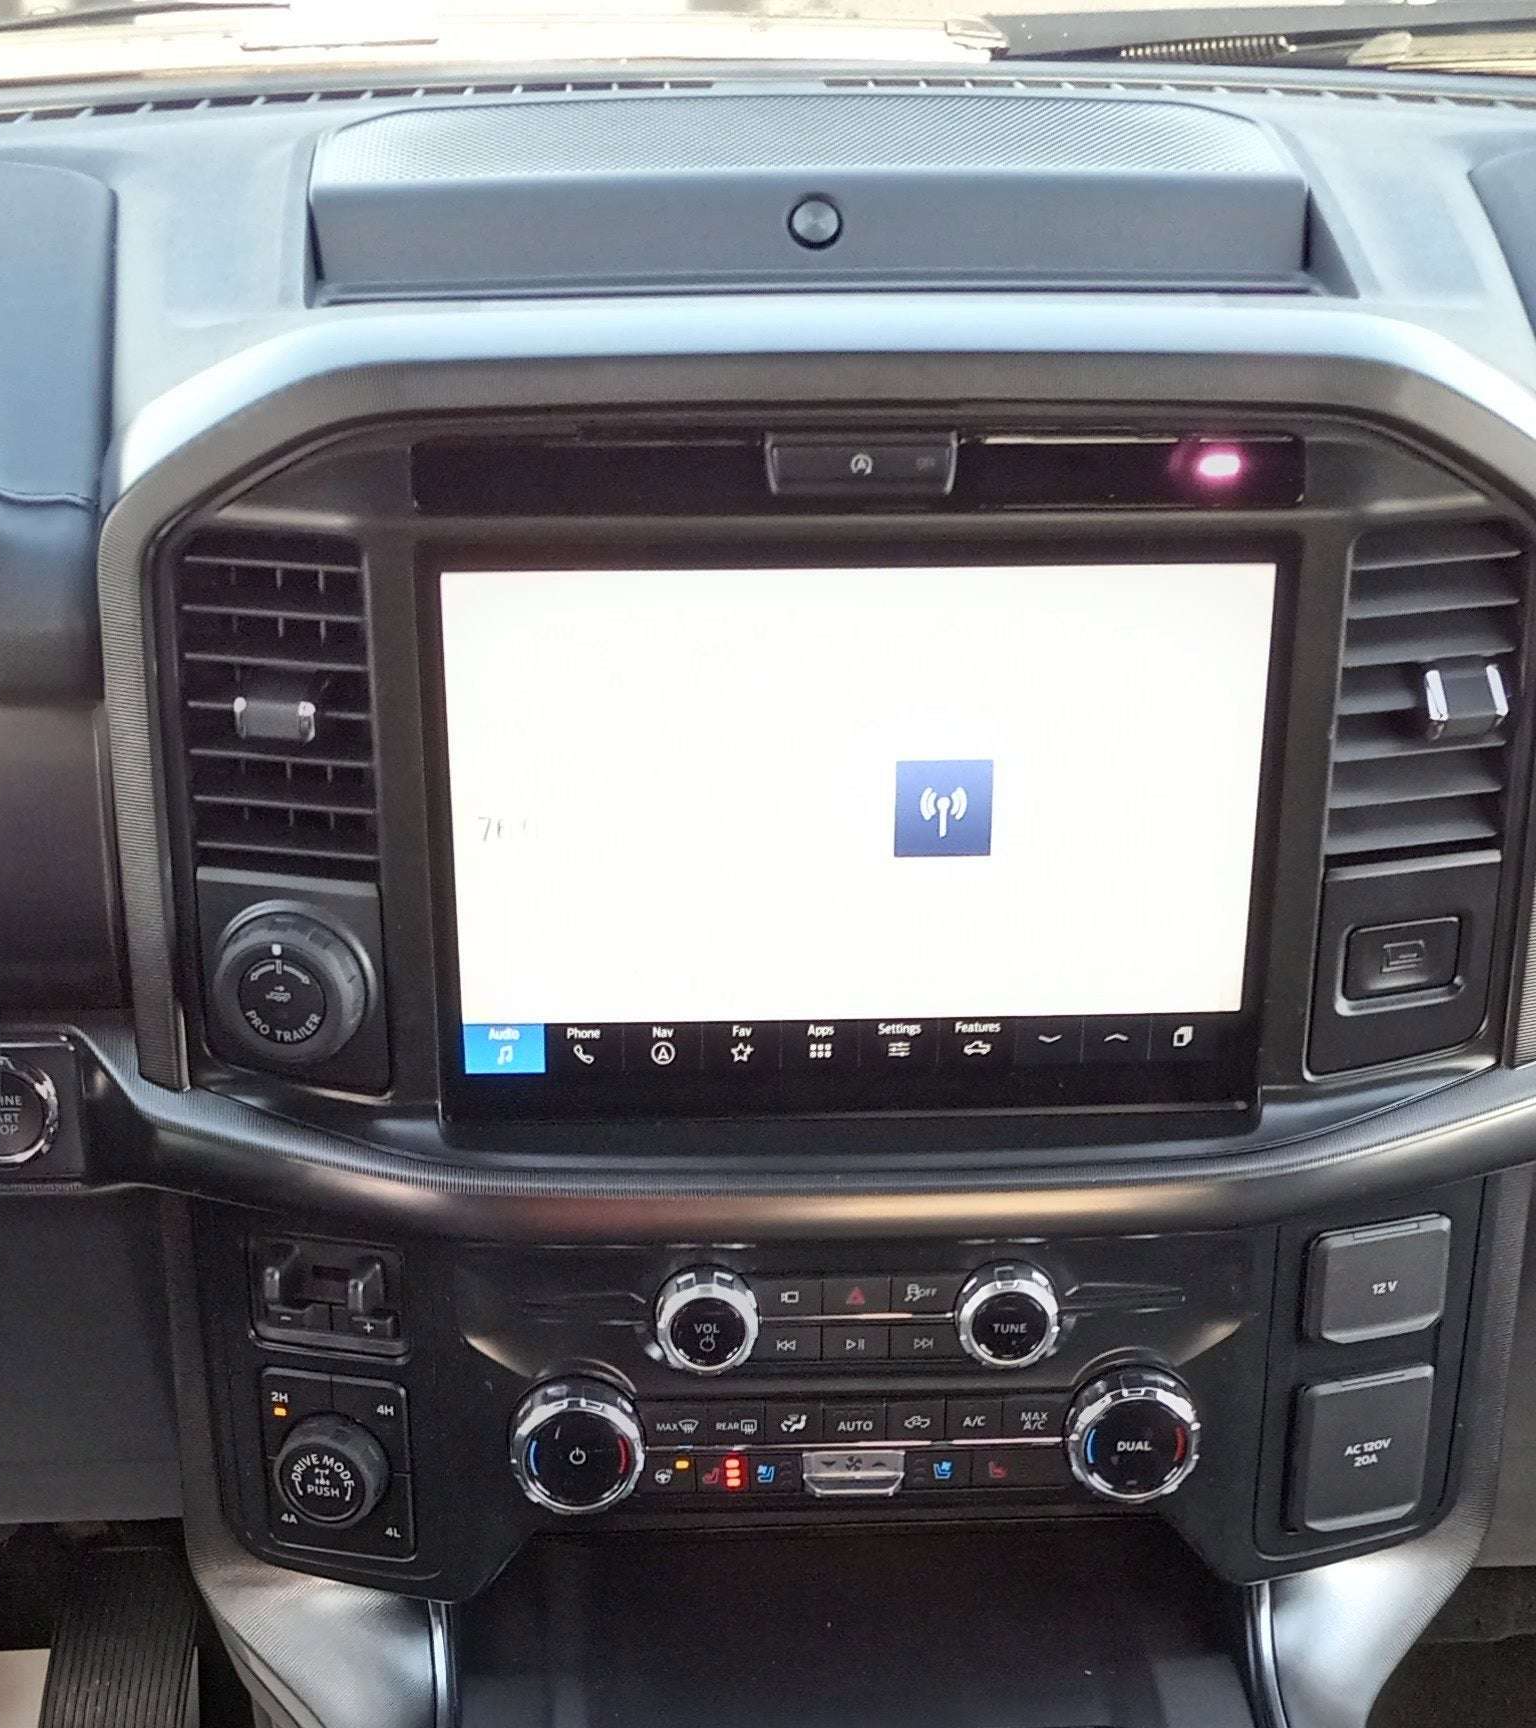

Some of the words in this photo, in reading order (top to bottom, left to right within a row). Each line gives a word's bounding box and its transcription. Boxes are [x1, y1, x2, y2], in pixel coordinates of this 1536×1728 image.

[246, 1008, 271, 1036] PRO
[274, 1012, 322, 1043] TRAILER
[488, 1026, 520, 1040] Audio
[566, 1026, 601, 1040] Phone
[652, 1025, 674, 1039] Nav
[732, 1024, 752, 1038] Fav
[807, 1024, 835, 1041] Apps
[877, 1021, 922, 1037] Settings
[954, 1020, 1001, 1034] Features
[694, 1323, 720, 1335] VOL
[993, 1323, 1028, 1335] TUNE
[271, 1391, 289, 1403] 2H
[376, 1403, 395, 1417] 4H
[1020, 1411, 1049, 1422] MAX
[656, 1420, 678, 1433] MAX
[716, 1420, 740, 1432] REAR
[837, 1420, 873, 1433] AUTO
[963, 1415, 987, 1429] A/C
[1023, 1421, 1046, 1432] A/C
[1116, 1438, 1153, 1452] DUAL
[1344, 1443, 1361, 1457] AC
[1363, 1437, 1392, 1453] 120V
[1353, 1453, 1378, 1468] 20A
[291, 1453, 320, 1482] DRIVE
[322, 1454, 356, 1488] MODE
[306, 1483, 341, 1498] PUSH
[281, 1512, 298, 1525] 4A
[386, 1526, 402, 1538] 4L
